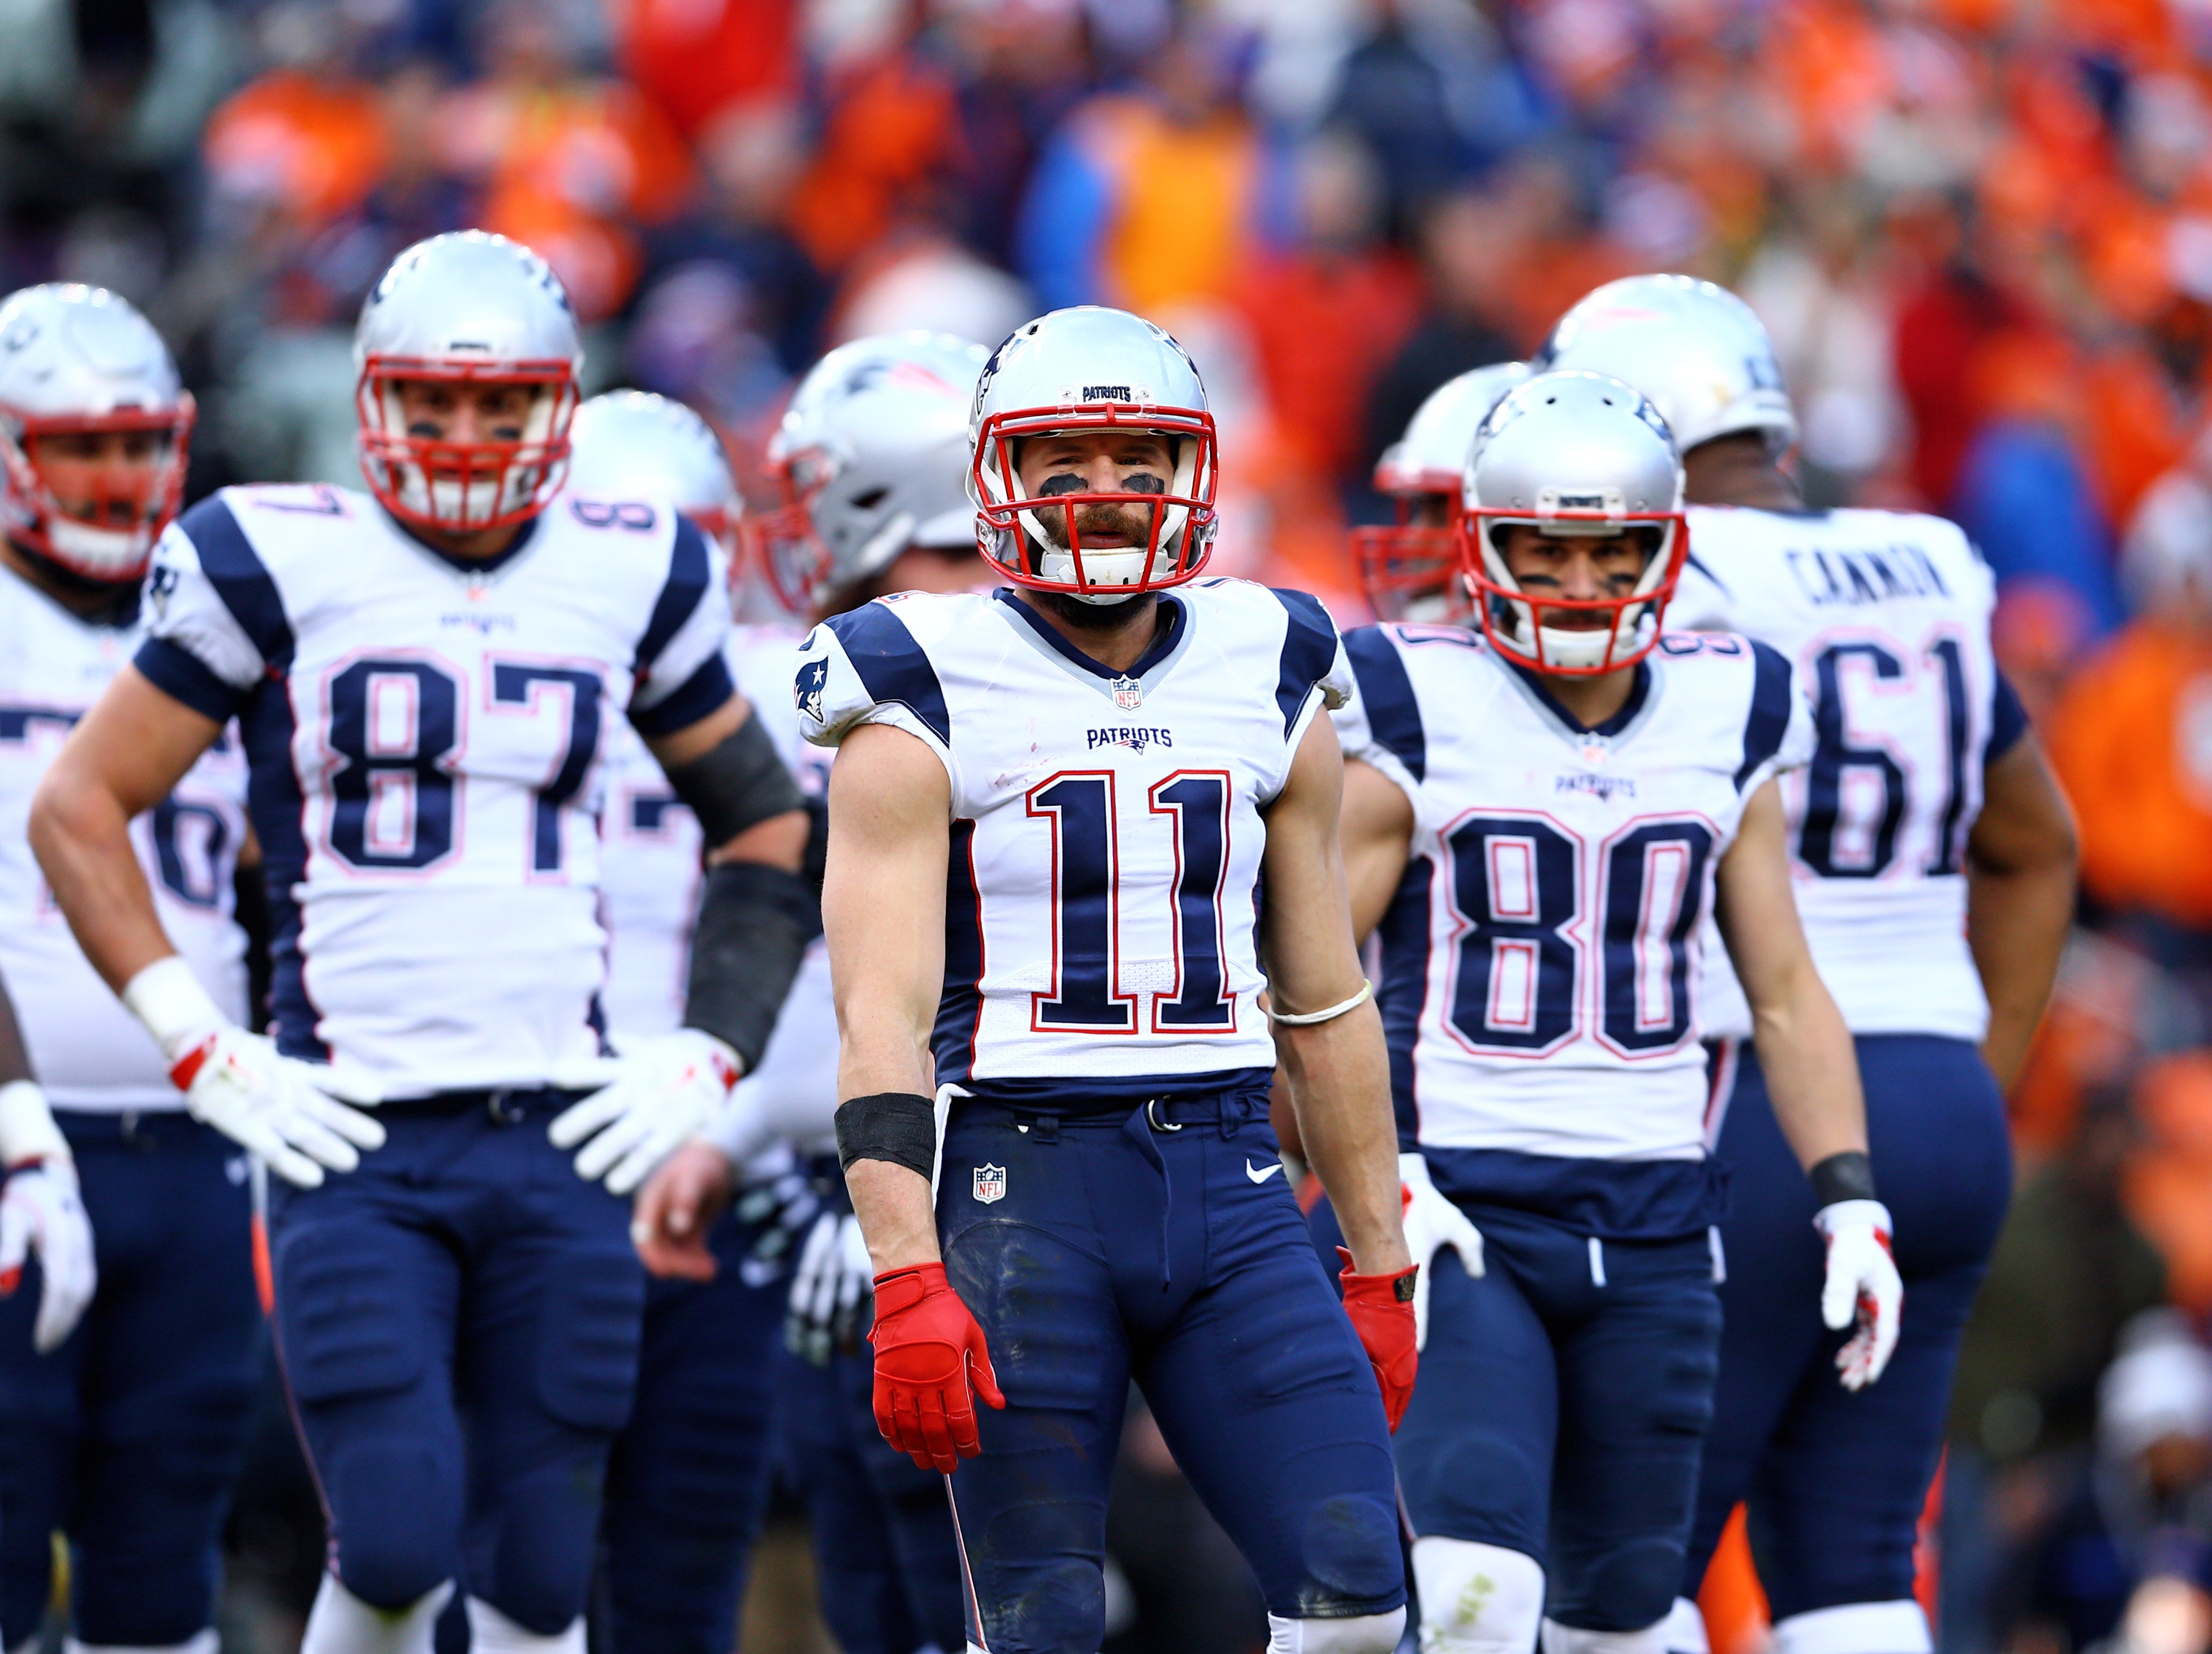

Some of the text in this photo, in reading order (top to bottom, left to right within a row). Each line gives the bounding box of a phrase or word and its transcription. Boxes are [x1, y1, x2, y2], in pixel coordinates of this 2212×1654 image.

[1082, 386, 1131, 403] PATRIOTS
[1087, 728, 1172, 750] PATRIOTS
[1118, 691, 1139, 707] NFL
[1792, 621, 1975, 883] 61
[320, 647, 608, 885] 87
[1026, 769, 1237, 1035] 11
[1437, 807, 1722, 1060] 80
[979, 1182, 1000, 1197] NFL
